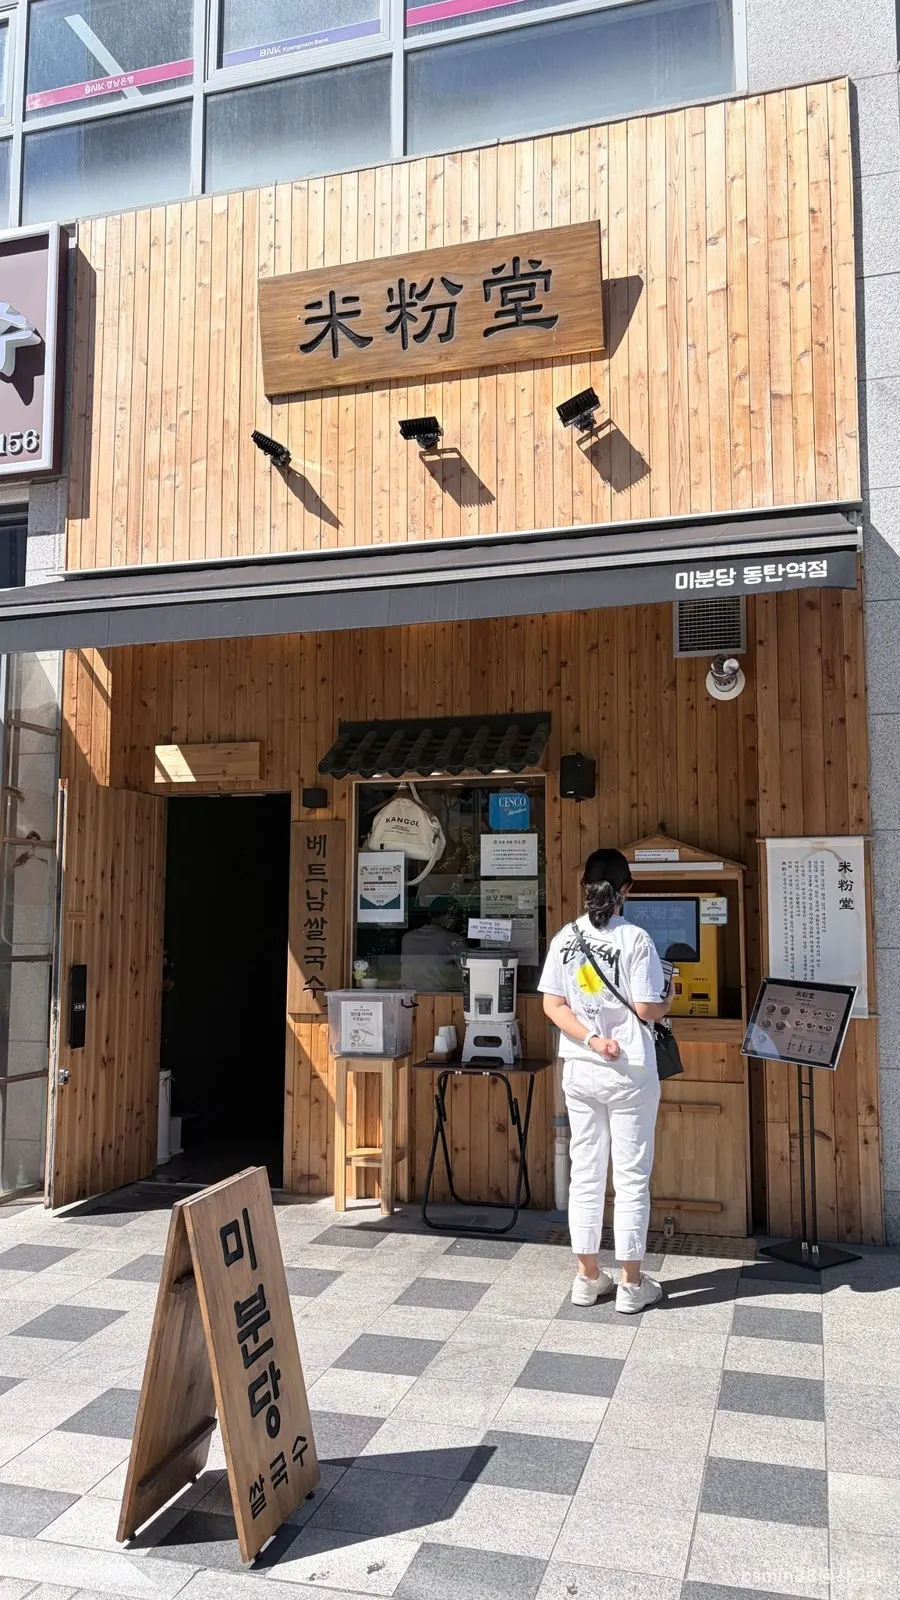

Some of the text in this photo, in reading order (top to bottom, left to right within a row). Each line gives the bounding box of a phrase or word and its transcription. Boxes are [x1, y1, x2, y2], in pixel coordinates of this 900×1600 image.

[259, 45, 282, 57] BNK
[314, 37, 330, 46] Bank
[84, 75, 135, 95] BNK 경남은행
[298, 255, 560, 360] 米粉堂
[675, 559, 829, 590] 미분당 동탄역점
[498, 796, 527, 808] CESCO
[385, 816, 420, 828] KANGOL
[838, 860, 854, 910] 米粉堂
[218, 1207, 283, 1439] 미분당
[248, 1435, 309, 1521] 쌀국수
